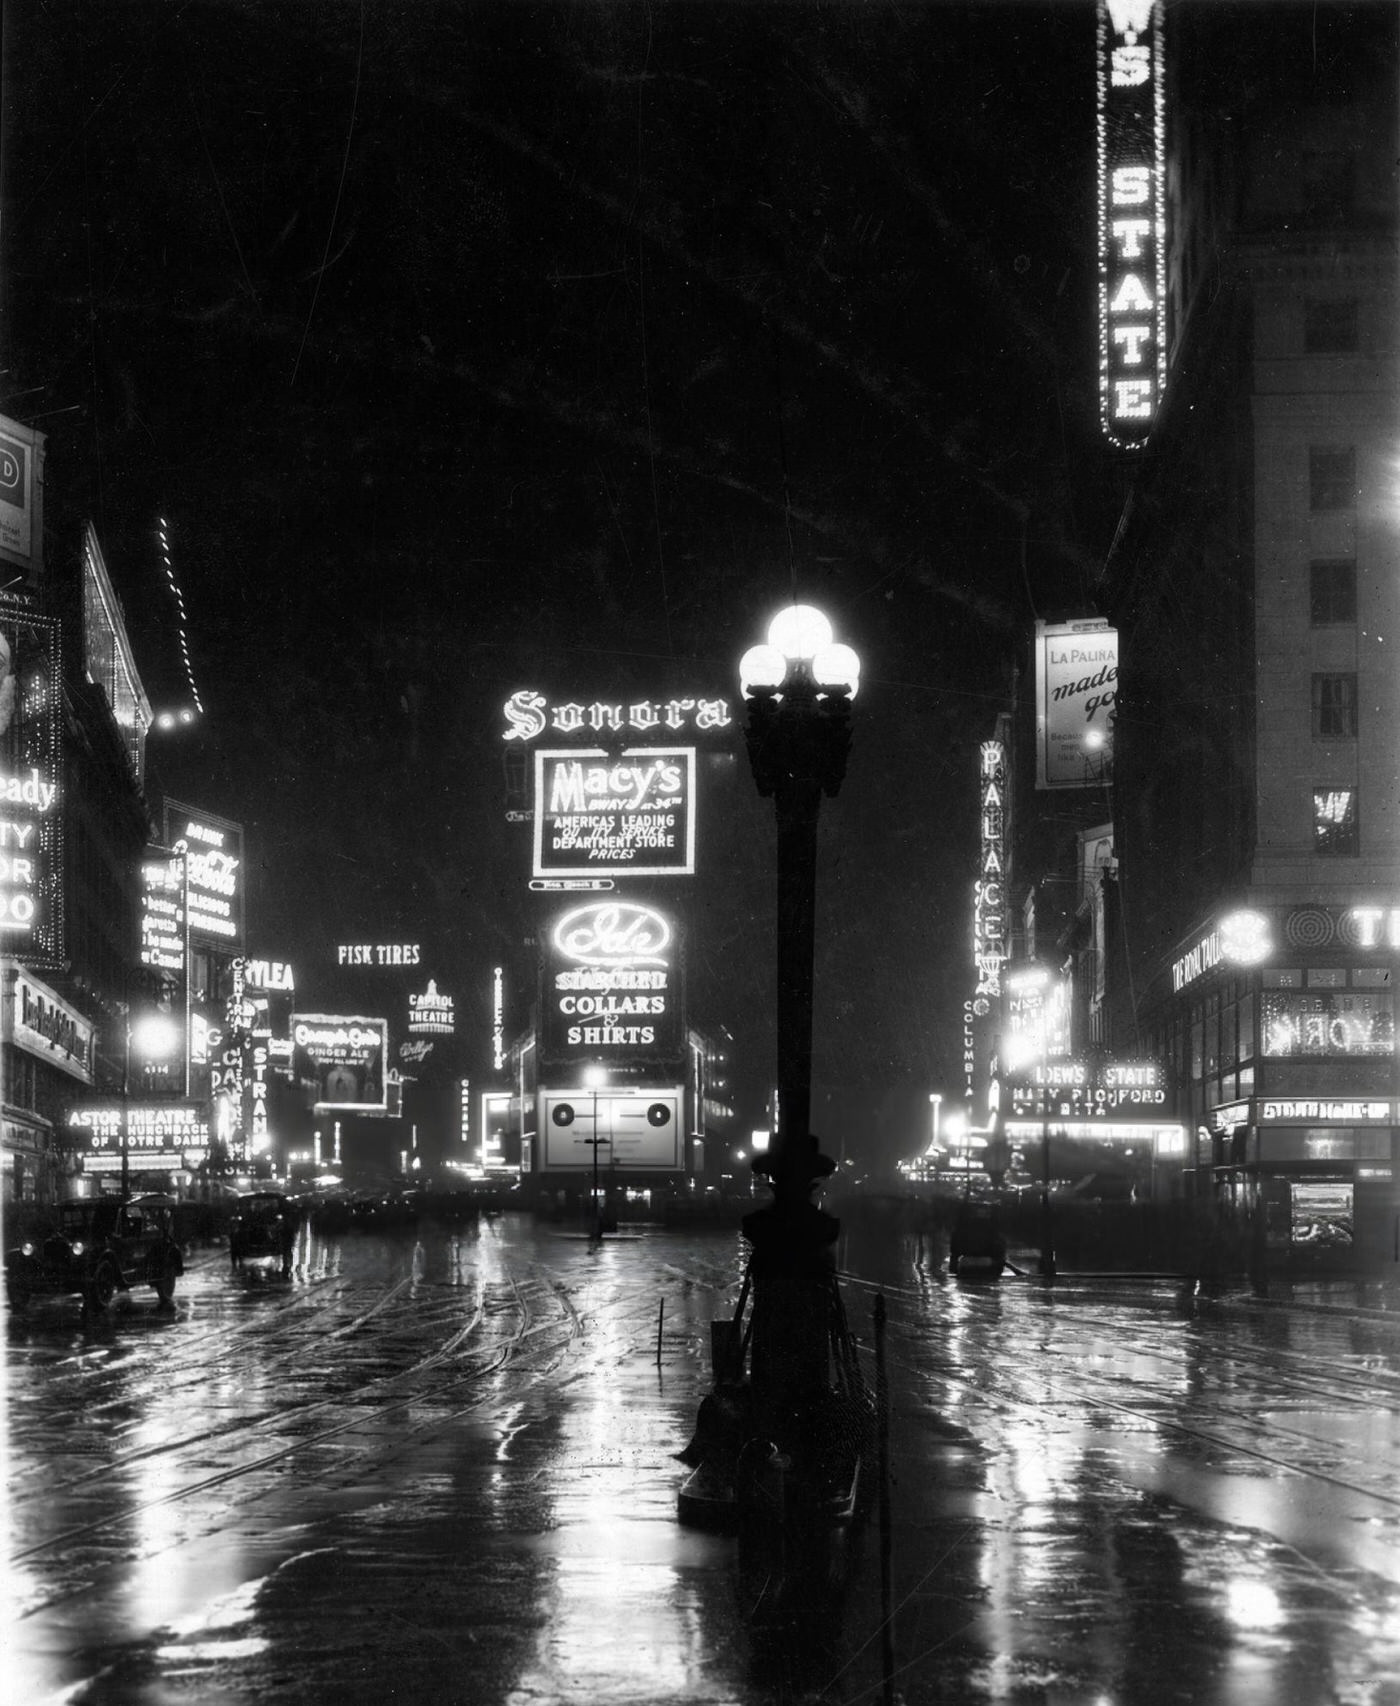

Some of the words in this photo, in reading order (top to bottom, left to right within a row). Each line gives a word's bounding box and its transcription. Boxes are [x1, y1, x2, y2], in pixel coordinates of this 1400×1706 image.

[1110, 166, 1153, 419] STATE
[1050, 651, 1068, 664] LA
[1051, 665, 1118, 701] made
[502, 691, 731, 741] Sonora
[550, 760, 682, 812] Macy's
[621, 814, 675, 827] LEADING
[553, 836, 632, 850] DEPARTMENT
[634, 835, 675, 848] STORE
[984, 750, 1001, 938] PALACE
[589, 849, 636, 860] PRICES
[338, 945, 373, 965] FISK
[376, 944, 421, 964] TIRES
[409, 994, 454, 1007] CAPITOL
[560, 997, 665, 1014] COLLARS
[408, 1011, 455, 1022] THEATRE
[604, 1014, 619, 1027] &
[568, 1027, 655, 1044] SHIRTS
[307, 1047, 347, 1058] GINGER
[351, 1049, 369, 1059] ALE
[963, 1001, 974, 1097] COLUMBIA
[1106, 1067, 1155, 1085] STATE
[253, 1047, 268, 1144] STRAN
[69, 1111, 122, 1127] ASTOR
[127, 1110, 196, 1125] THEATRE
[92, 1126, 118, 1136] THE
[128, 1124, 208, 1136] HUNCHBACK
[92, 1136, 109, 1147] OF
[173, 1135, 209, 1146] DAME
